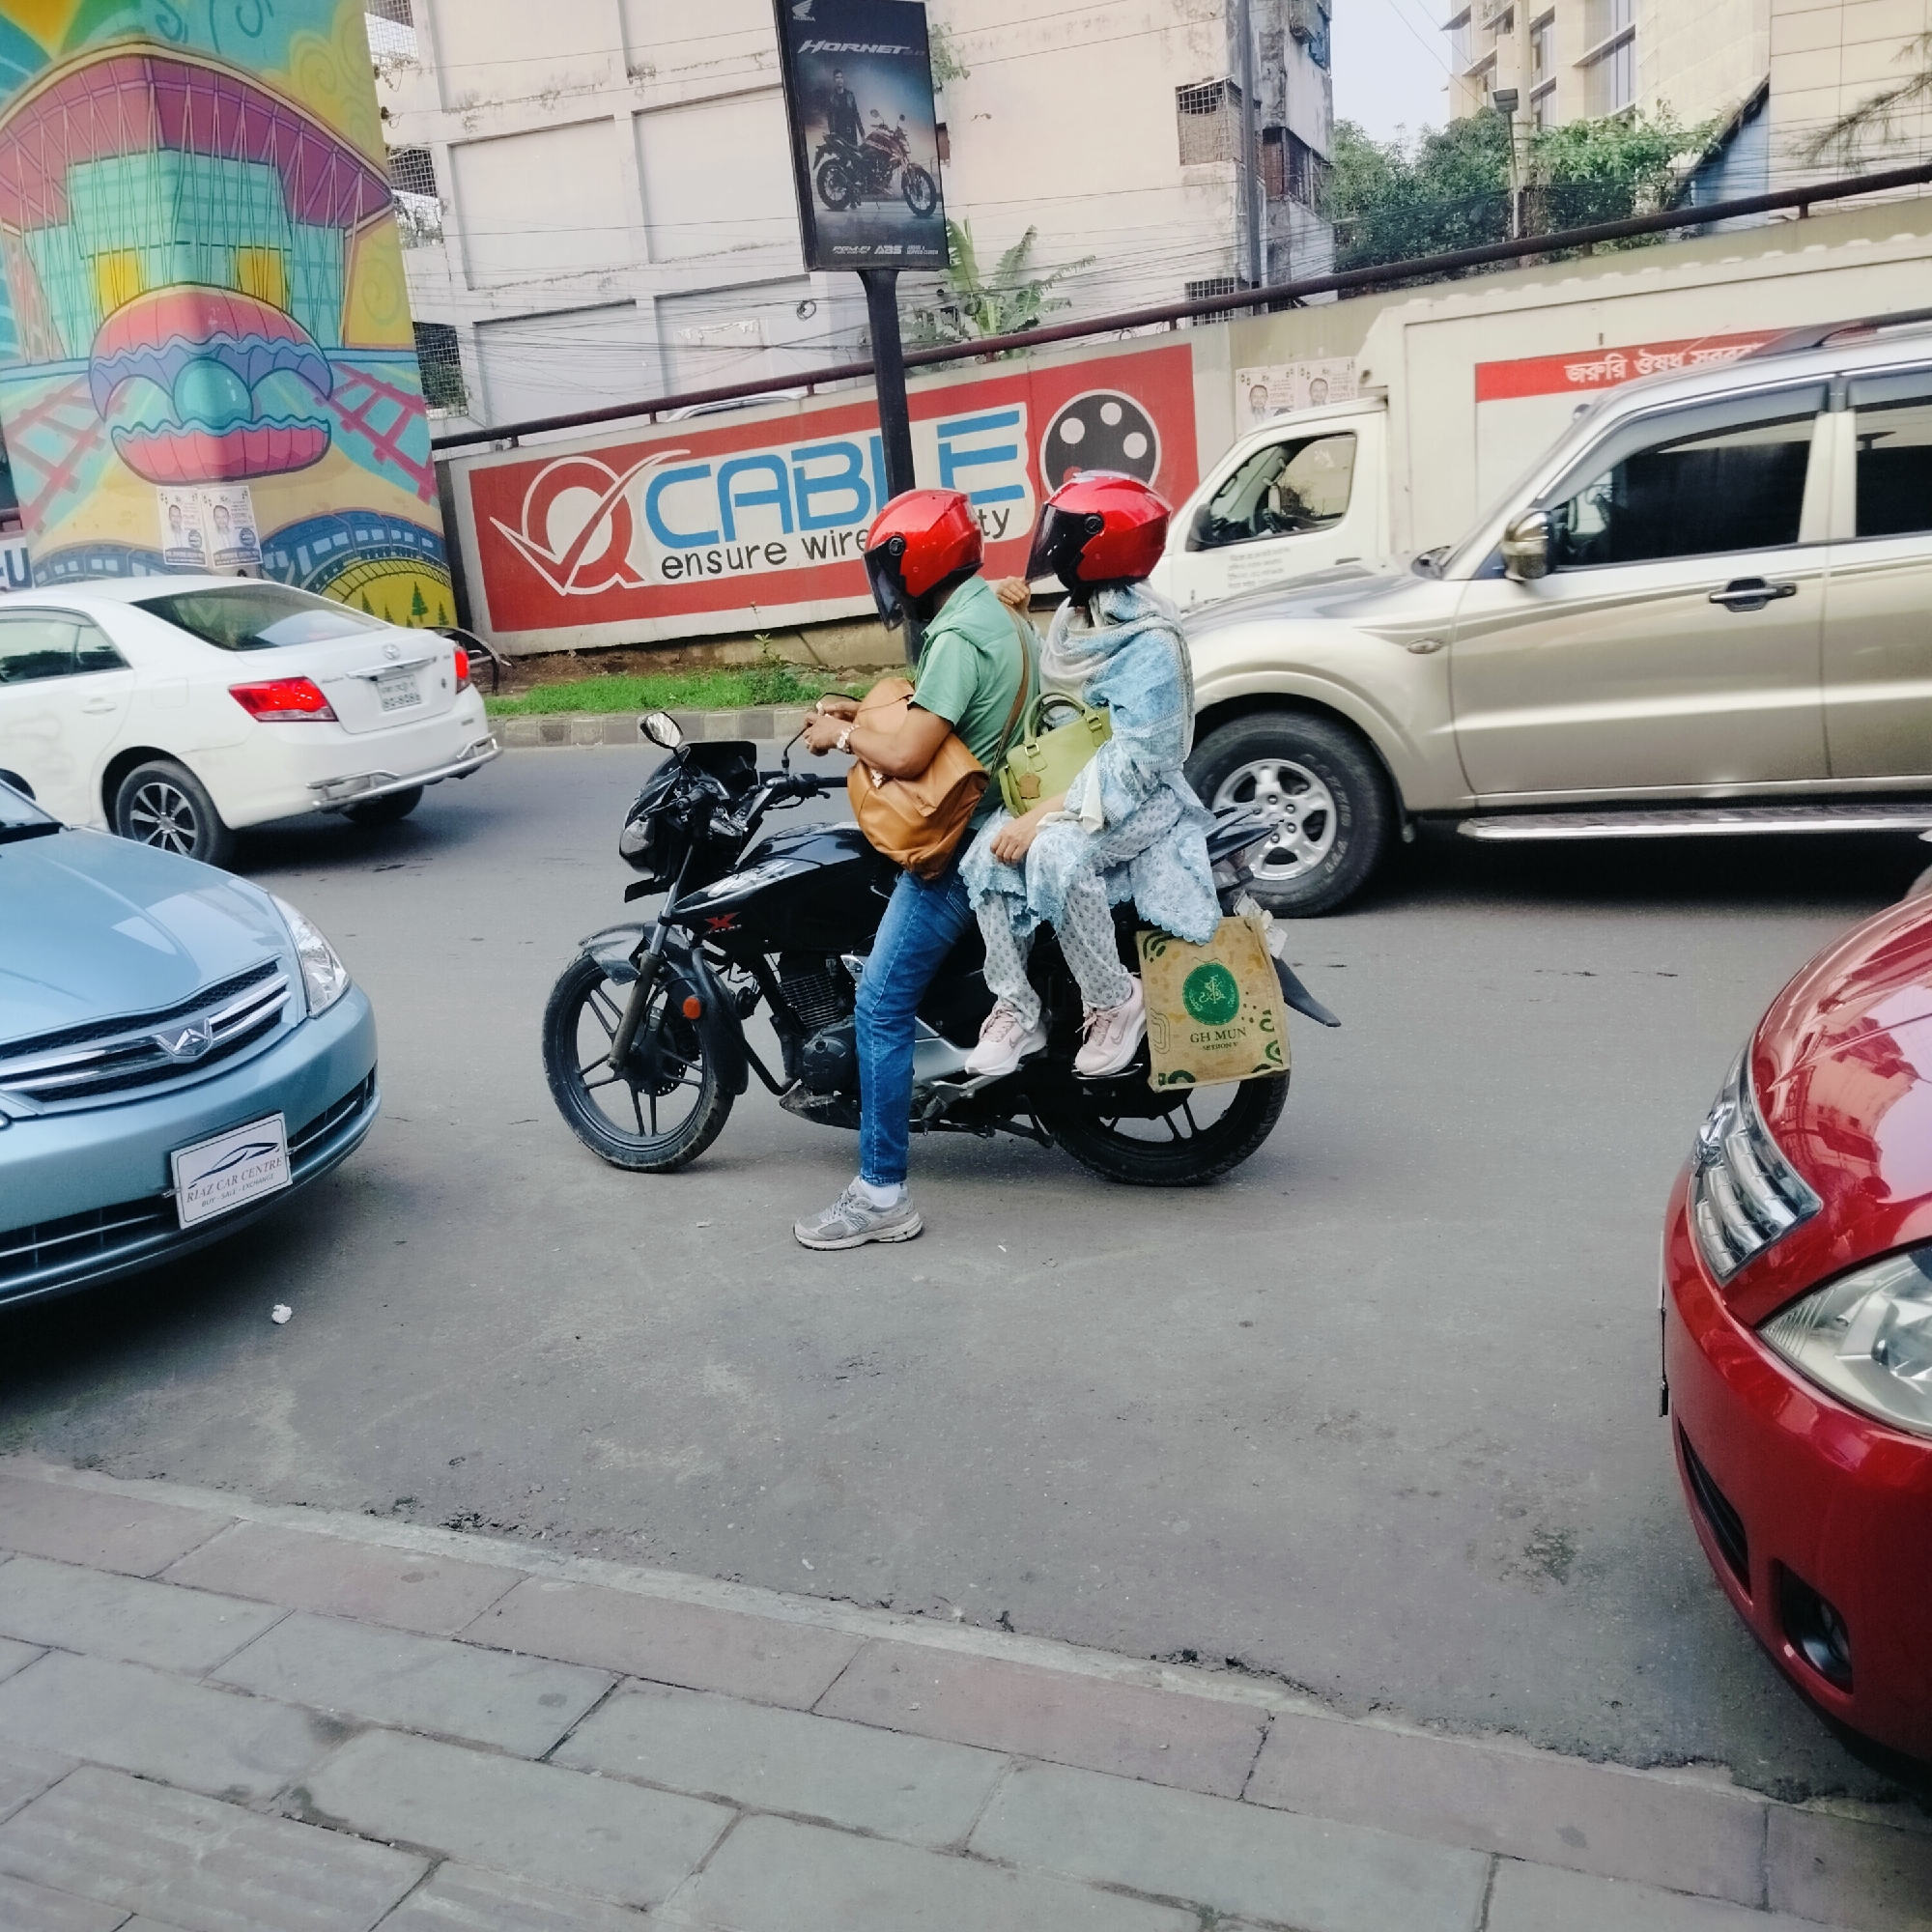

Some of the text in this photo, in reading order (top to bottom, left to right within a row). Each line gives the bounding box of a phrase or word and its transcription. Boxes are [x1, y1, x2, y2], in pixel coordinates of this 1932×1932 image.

[797, 40, 910, 55] HORNET
[874, 244, 903, 255] ABS
[1564, 352, 1628, 383] জরুরি
[661, 541, 787, 580] ensure
[1190, 1027, 1247, 1043] GH MUN
[186, 1156, 283, 1203] RIAZ CAR CENTRE
[201, 1198, 215, 1208] BUY
